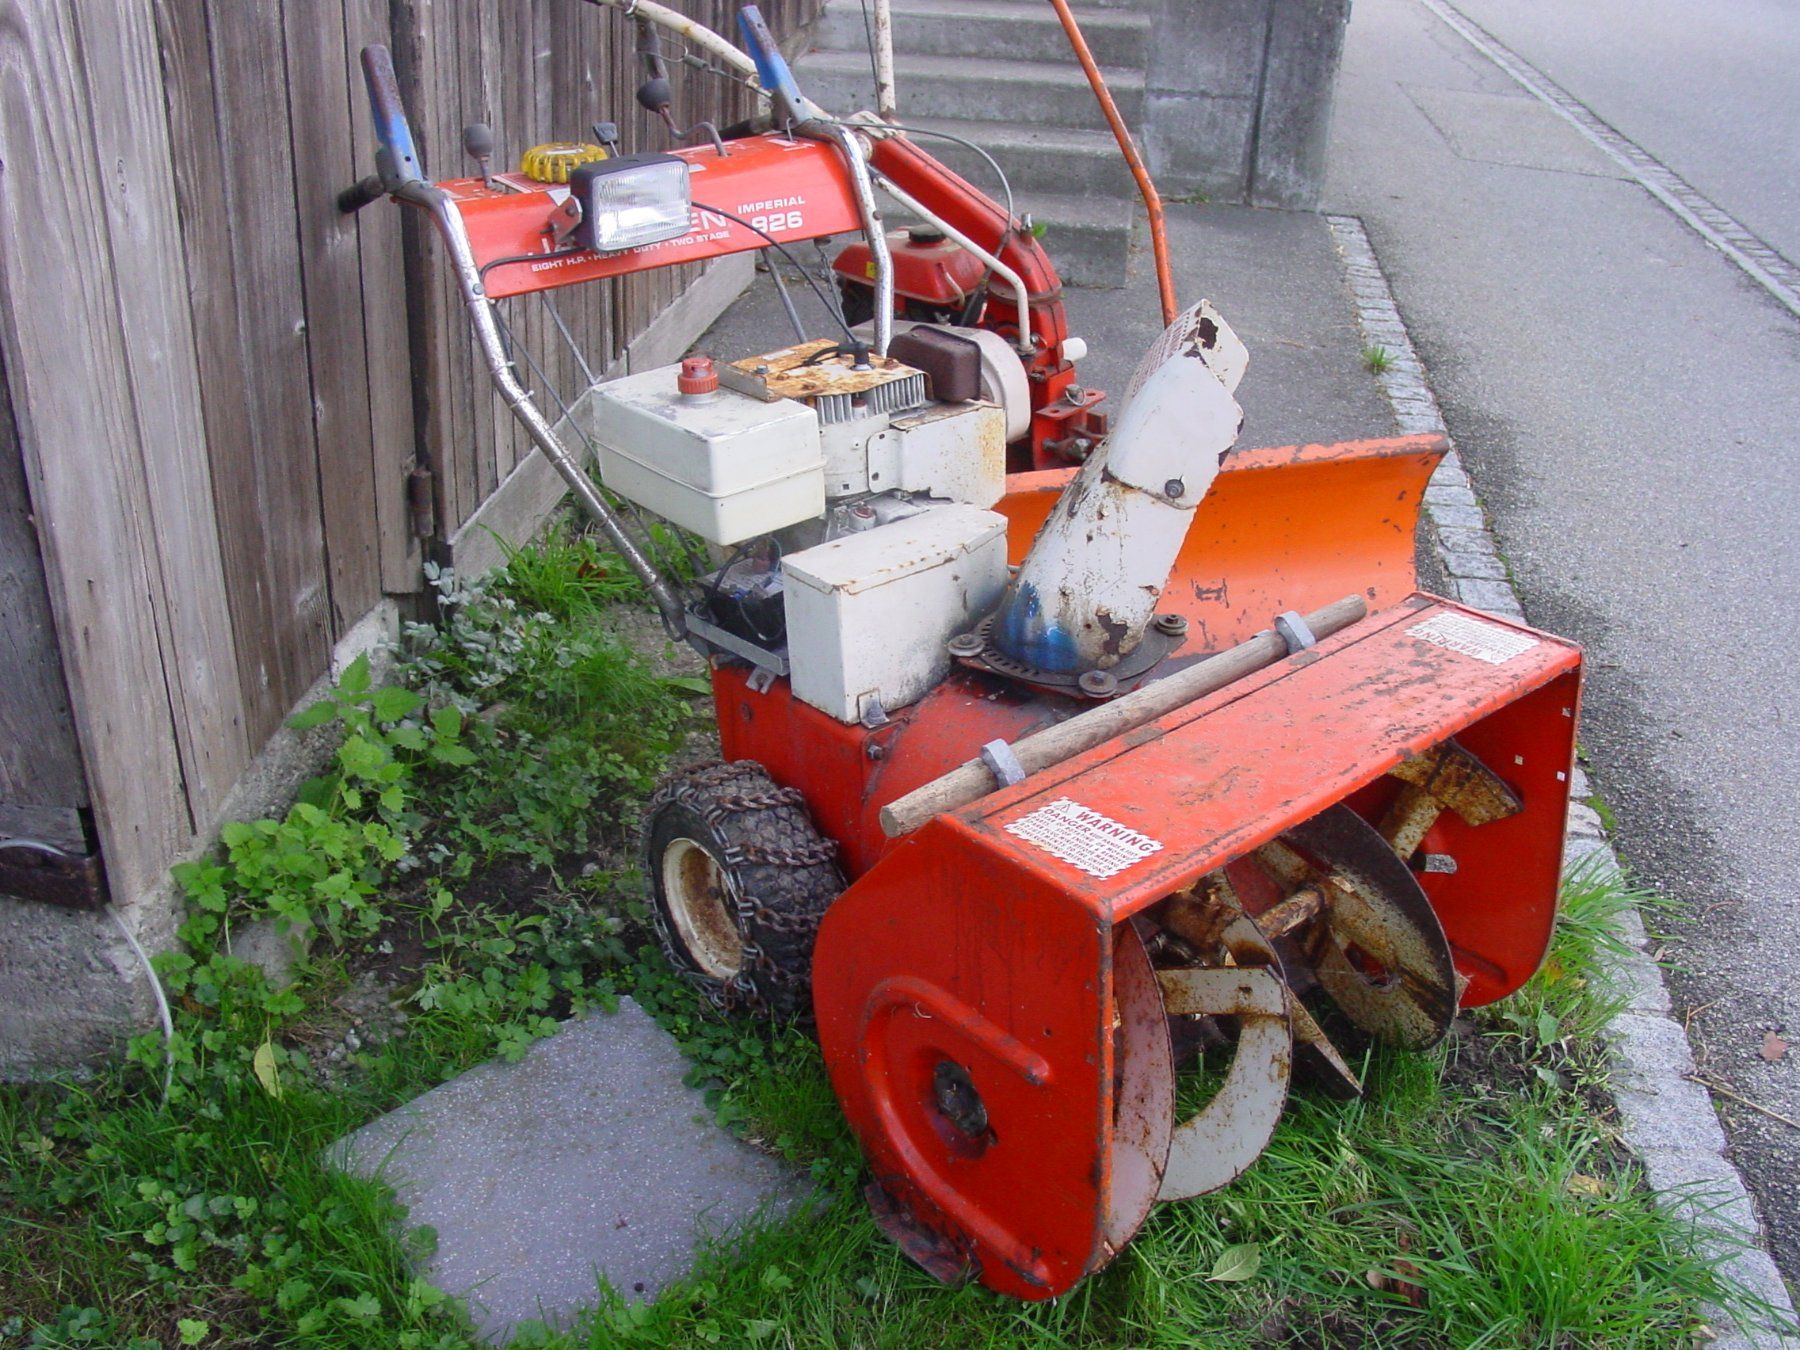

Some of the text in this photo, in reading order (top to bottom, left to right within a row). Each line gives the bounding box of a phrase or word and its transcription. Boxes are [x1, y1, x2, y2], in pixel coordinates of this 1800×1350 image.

[737, 195, 805, 214] IMPERIAL
[751, 210, 804, 235] 926
[531, 259, 564, 272] EIGHT
[593, 249, 629, 262] HEAVY
[633, 241, 661, 254] DUTY
[671, 236, 695, 247] TWO
[696, 230, 730, 242] STAGE
[1043, 808, 1092, 833] DANGER
[1076, 811, 1154, 852] WARNING
